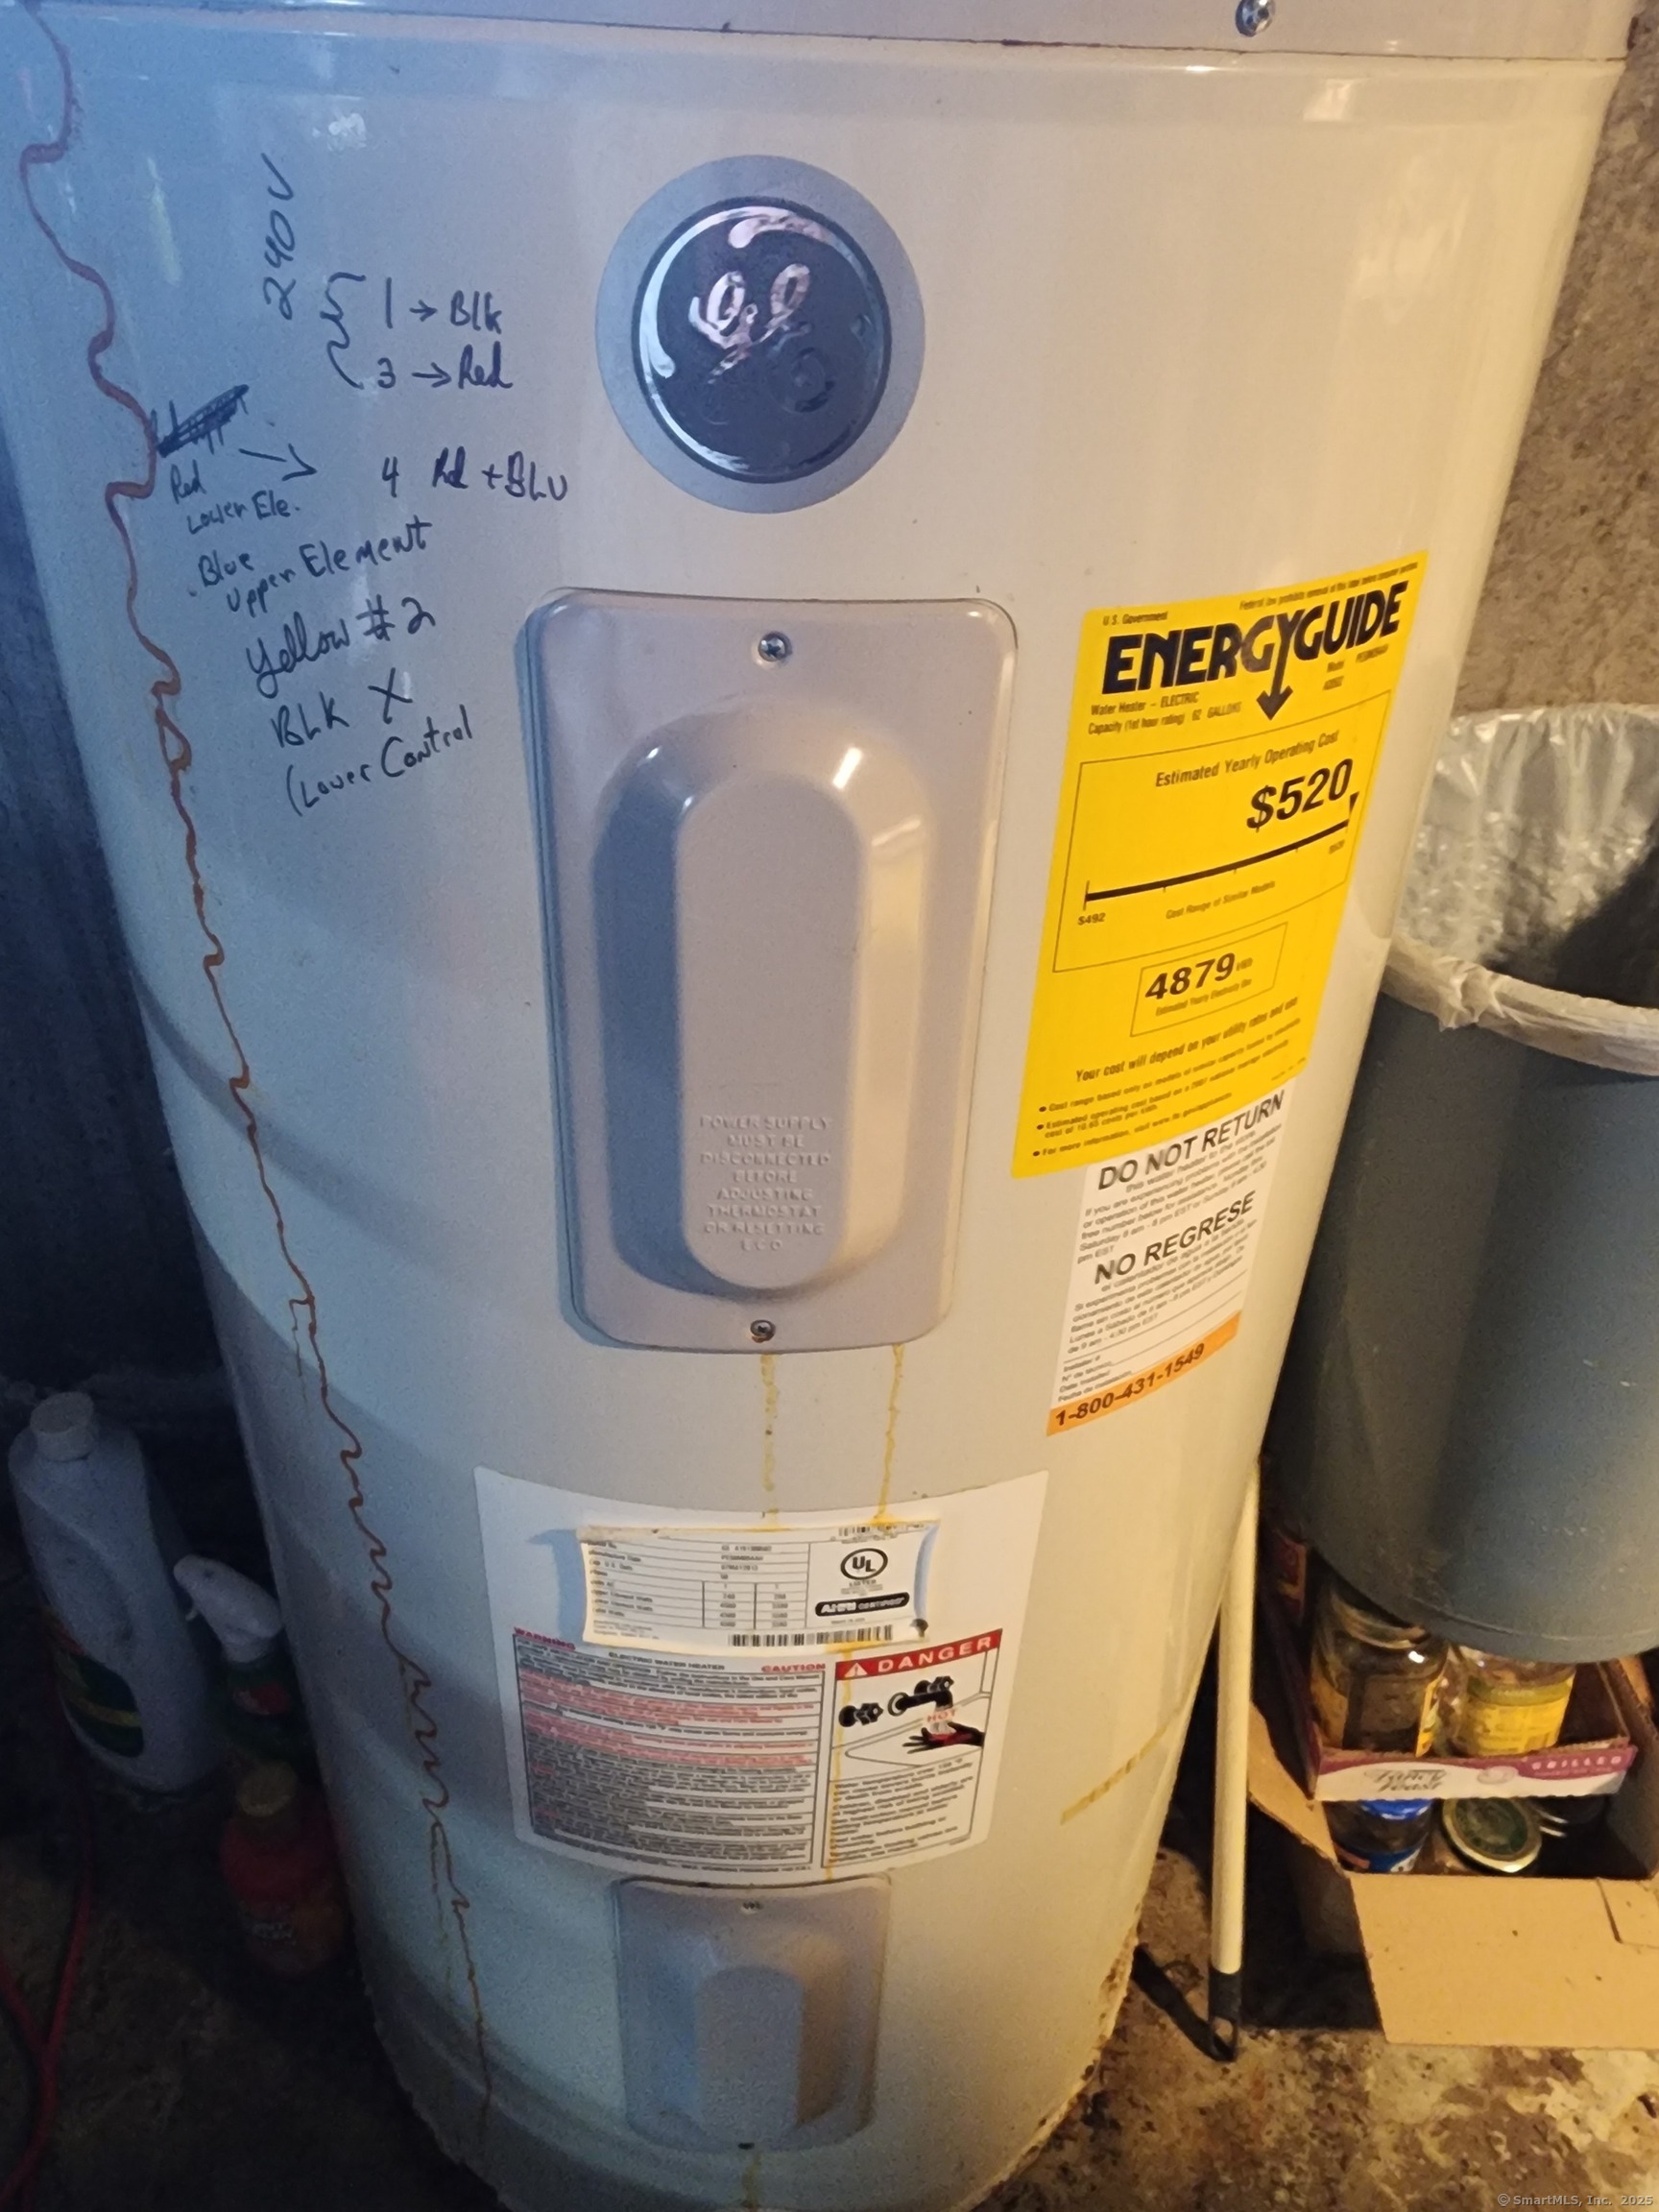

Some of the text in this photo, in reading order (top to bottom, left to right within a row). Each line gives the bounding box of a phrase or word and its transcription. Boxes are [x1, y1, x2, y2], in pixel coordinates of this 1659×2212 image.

[376, 357, 397, 389] 3
[382, 456, 399, 498] 4
[187, 501, 249, 535] Lower
[1101, 580, 1409, 720] ENERGYGUIDE
[1091, 691, 1200, 716] Water Heater ELECTRIC
[1088, 722, 1122, 736] Capacity
[1155, 730, 1340, 788] Estimated Yearly Operating Cost
[1246, 757, 1355, 833] $520
[1145, 952, 1237, 1000] 4879
[1076, 1069, 1101, 1083] Your
[1103, 1061, 1125, 1076] cost
[1128, 1054, 1147, 1070] will
[1149, 1043, 1186, 1065] depend
[700, 1115, 833, 1131] POWER SUPPLY
[727, 1133, 777, 1148] MUST
[1097, 1159, 1140, 1191] DO
[1144, 1135, 1200, 1175] NOT
[1201, 1089, 1286, 1152] RETURN
[700, 1151, 831, 1166] DISCONNECTED
[733, 1169, 799, 1184] BEFORE
[717, 1187, 815, 1201] ADJUSTING
[707, 1204, 823, 1218] THERMOSTAT
[704, 1221, 827, 1237] OR RESETTING
[1094, 1253, 1136, 1285] NO
[1143, 1190, 1257, 1266] REGRESE
[1055, 1342, 1206, 1427] 1-800-431-1549
[852, 1555, 877, 1573] UL
[513, 1626, 577, 1652] WARNING
[608, 1651, 725, 1671] ELECTRIC WATER HEATER
[878, 1636, 992, 1673] DANGER
[760, 1663, 827, 1673] CAUTION
[926, 1709, 957, 1723] HOT
